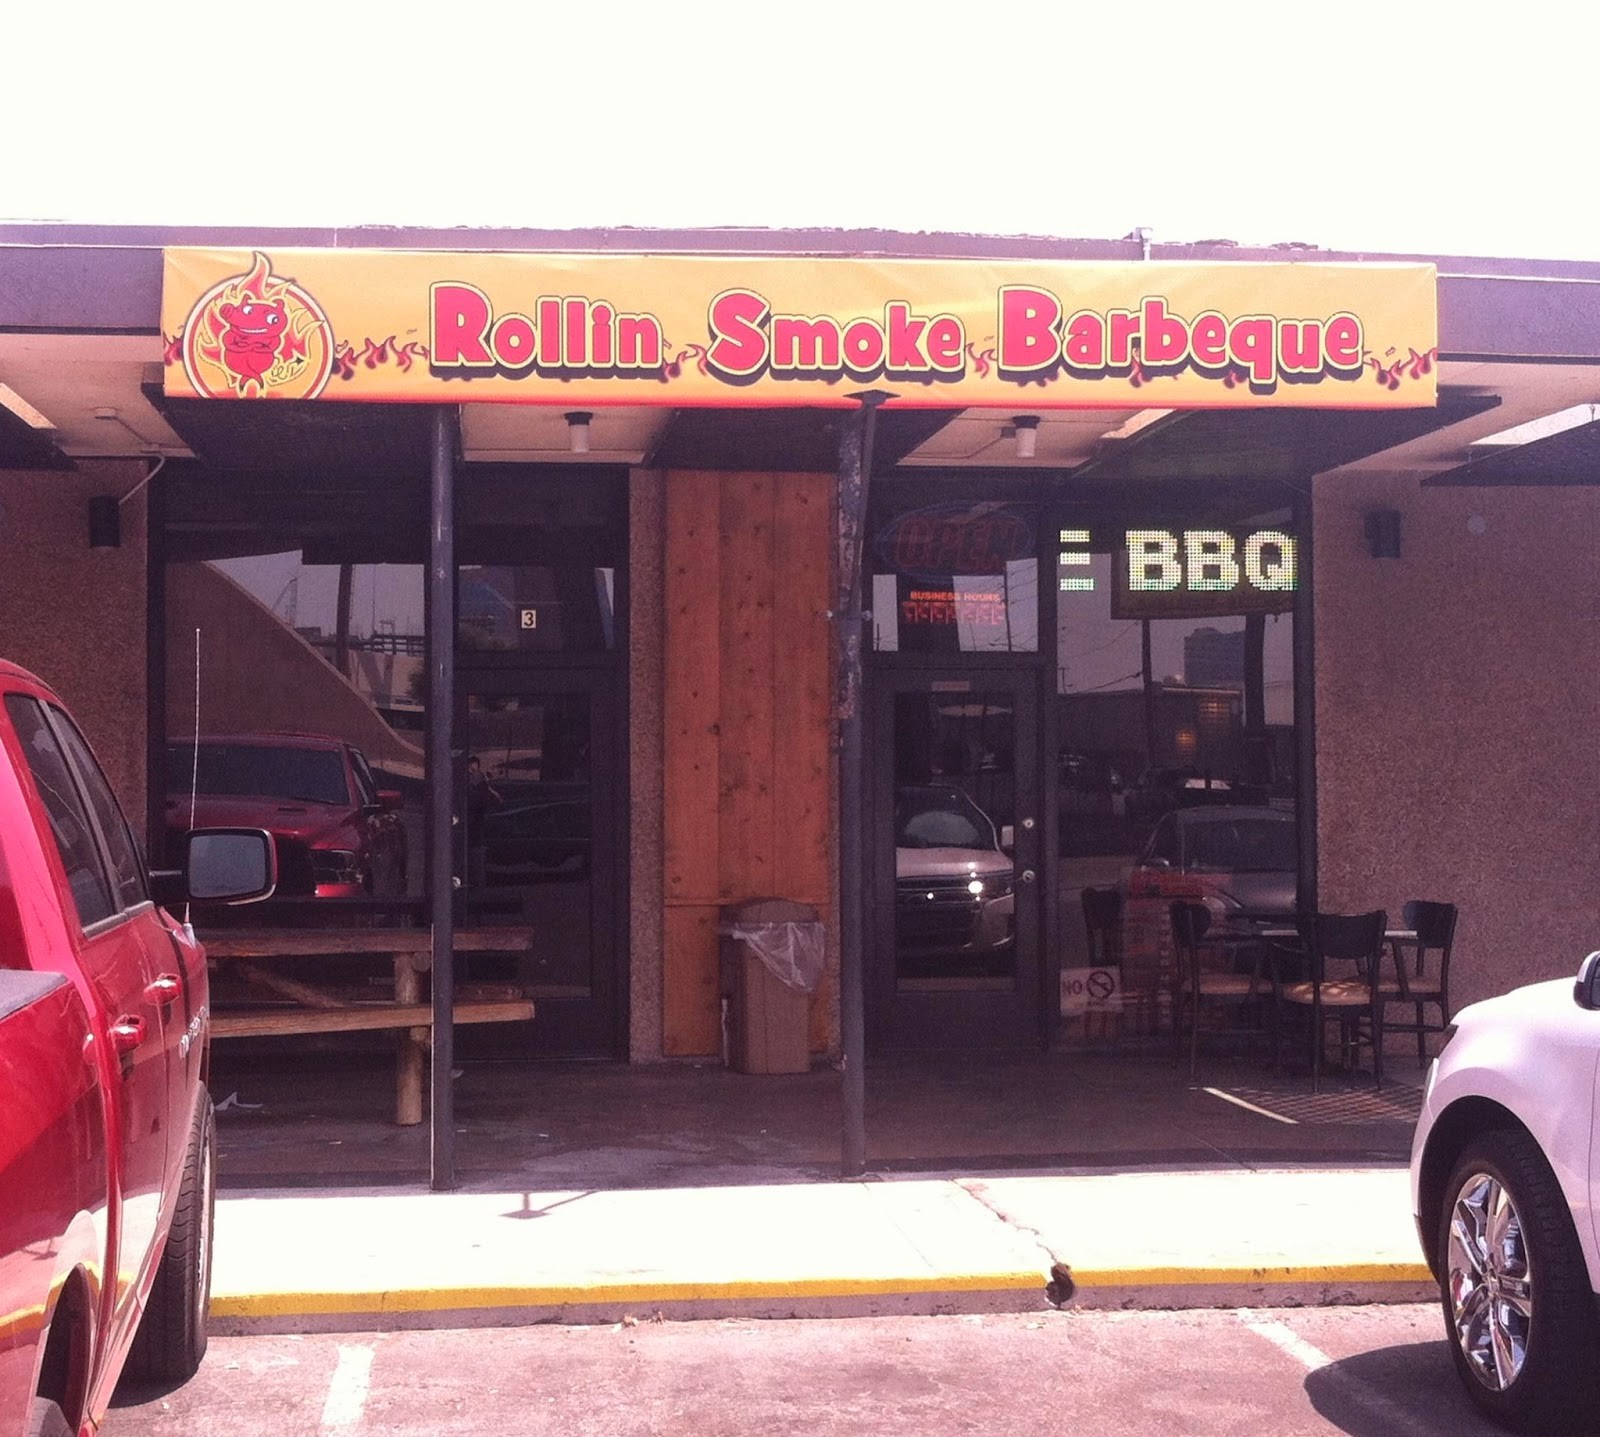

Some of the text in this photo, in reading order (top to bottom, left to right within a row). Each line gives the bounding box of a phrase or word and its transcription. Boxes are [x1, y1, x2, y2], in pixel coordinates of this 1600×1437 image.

[430, 281, 1365, 386] Rollin Smoke Barbeque
[1125, 529, 1298, 592] BBQ
[523, 611, 535, 628] 3
